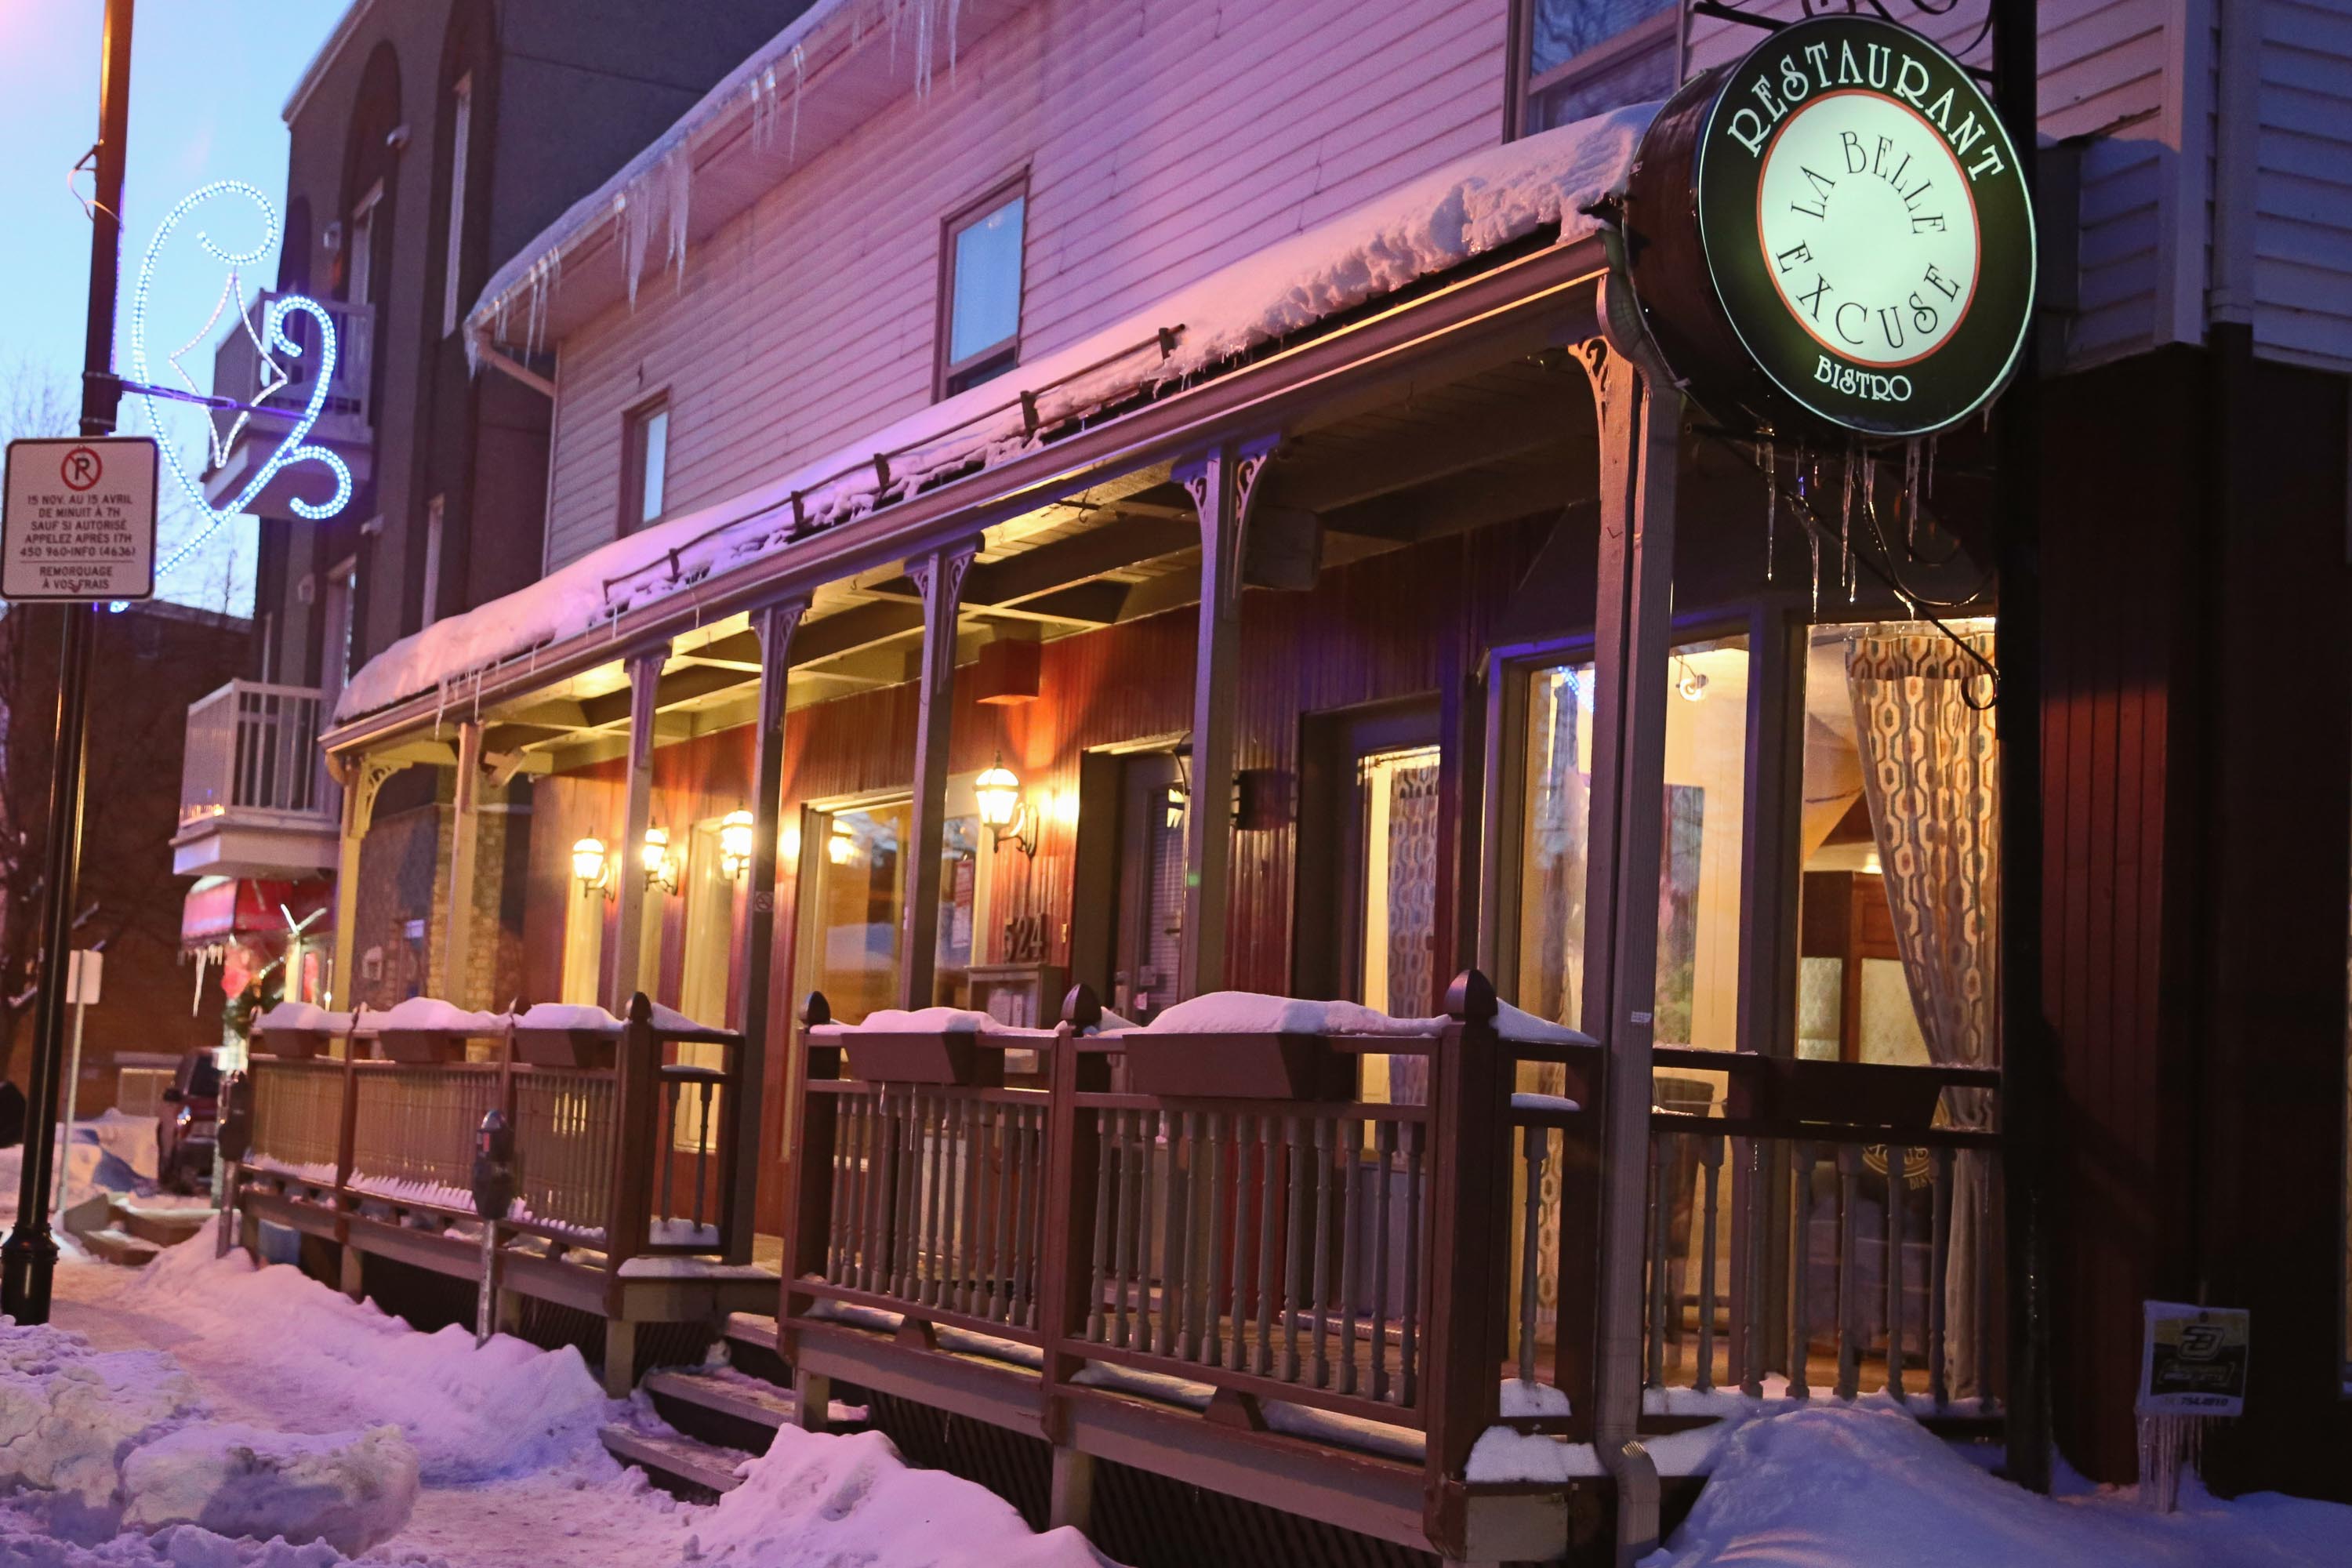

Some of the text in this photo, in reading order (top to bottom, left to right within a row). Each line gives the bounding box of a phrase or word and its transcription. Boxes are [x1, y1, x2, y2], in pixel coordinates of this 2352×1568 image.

[1727, 39, 2005, 181] RESTAURANT
[1791, 130, 1947, 234] LA BELLE
[1776, 240, 1962, 349] EXCUSE
[1813, 355, 1912, 401] BISTRO
[27, 495, 38, 505] 15
[69, 495, 84, 504] AU
[88, 495, 98, 504] 15
[102, 494, 132, 504] AVRIL
[38, 506, 121, 518] DE MINUIT À 7H
[31, 519, 127, 531] SAUF SI AUTORISÉ
[24, 534, 72, 544] APPELEZ
[113, 534, 132, 543] 17H
[20, 547, 42, 557] 450
[40, 566, 113, 576] REMORQUAGE
[54, 579, 77, 589] VOS
[79, 579, 110, 589] FRAIS
